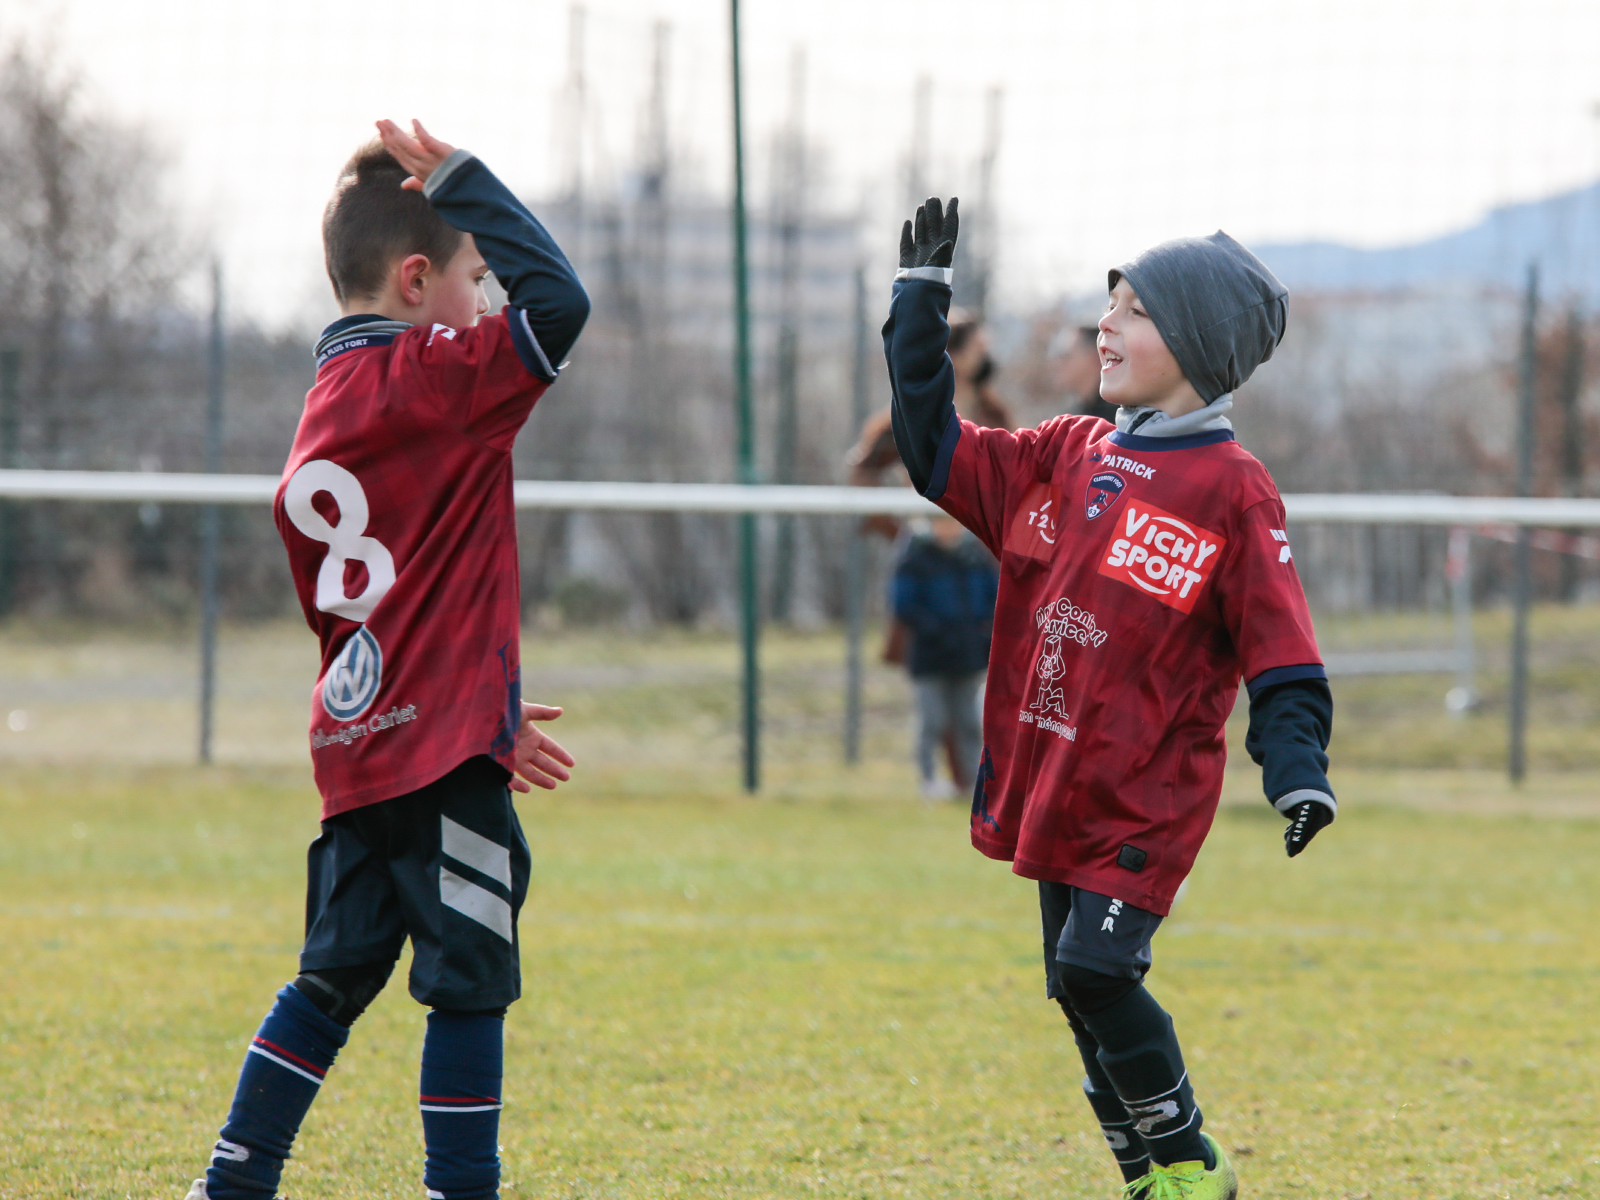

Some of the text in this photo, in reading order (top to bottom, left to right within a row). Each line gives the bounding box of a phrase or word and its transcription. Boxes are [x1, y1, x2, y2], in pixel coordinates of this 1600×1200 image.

[326, 338, 369, 356] PLUS FORT
[1101, 454, 1157, 480] PATRICK
[284, 459, 397, 623] 8
[1126, 508, 1217, 569] VICHY
[1107, 538, 1202, 599] SPORT
[368, 703, 418, 732] Carlet
